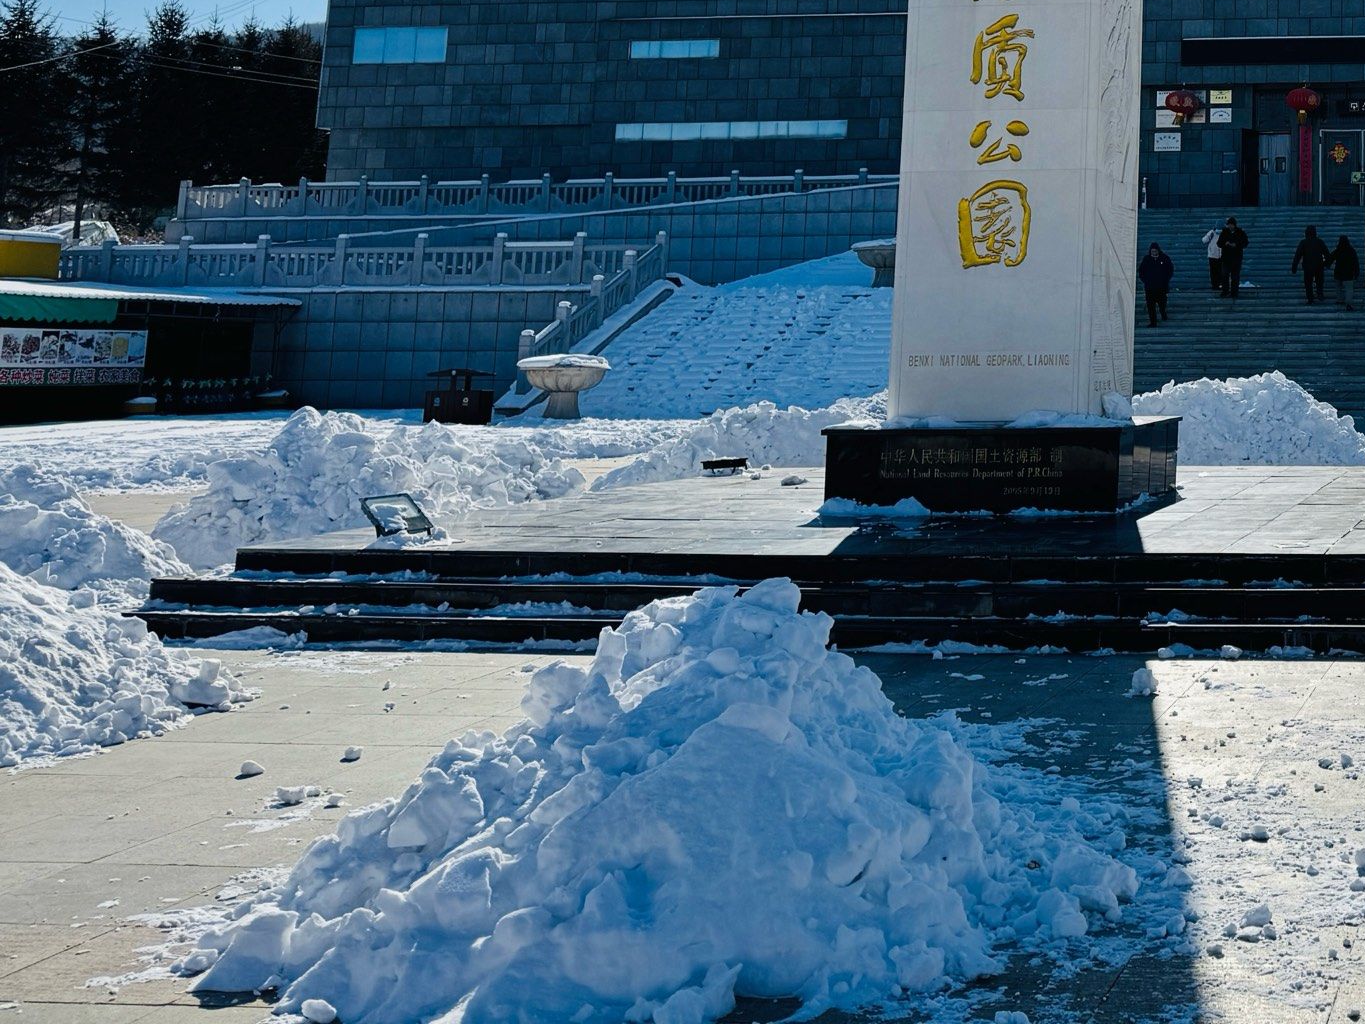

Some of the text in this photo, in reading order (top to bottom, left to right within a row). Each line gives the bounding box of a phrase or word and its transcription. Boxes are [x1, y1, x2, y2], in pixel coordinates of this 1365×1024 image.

[908, 355, 934, 367] BENXI
[939, 354, 981, 367] NATIONAL
[880, 468, 909, 479] National
[913, 468, 930, 478] Land
[934, 468, 969, 479] Resources
[973, 468, 1014, 480] Department
[1017, 467, 1025, 478] of
